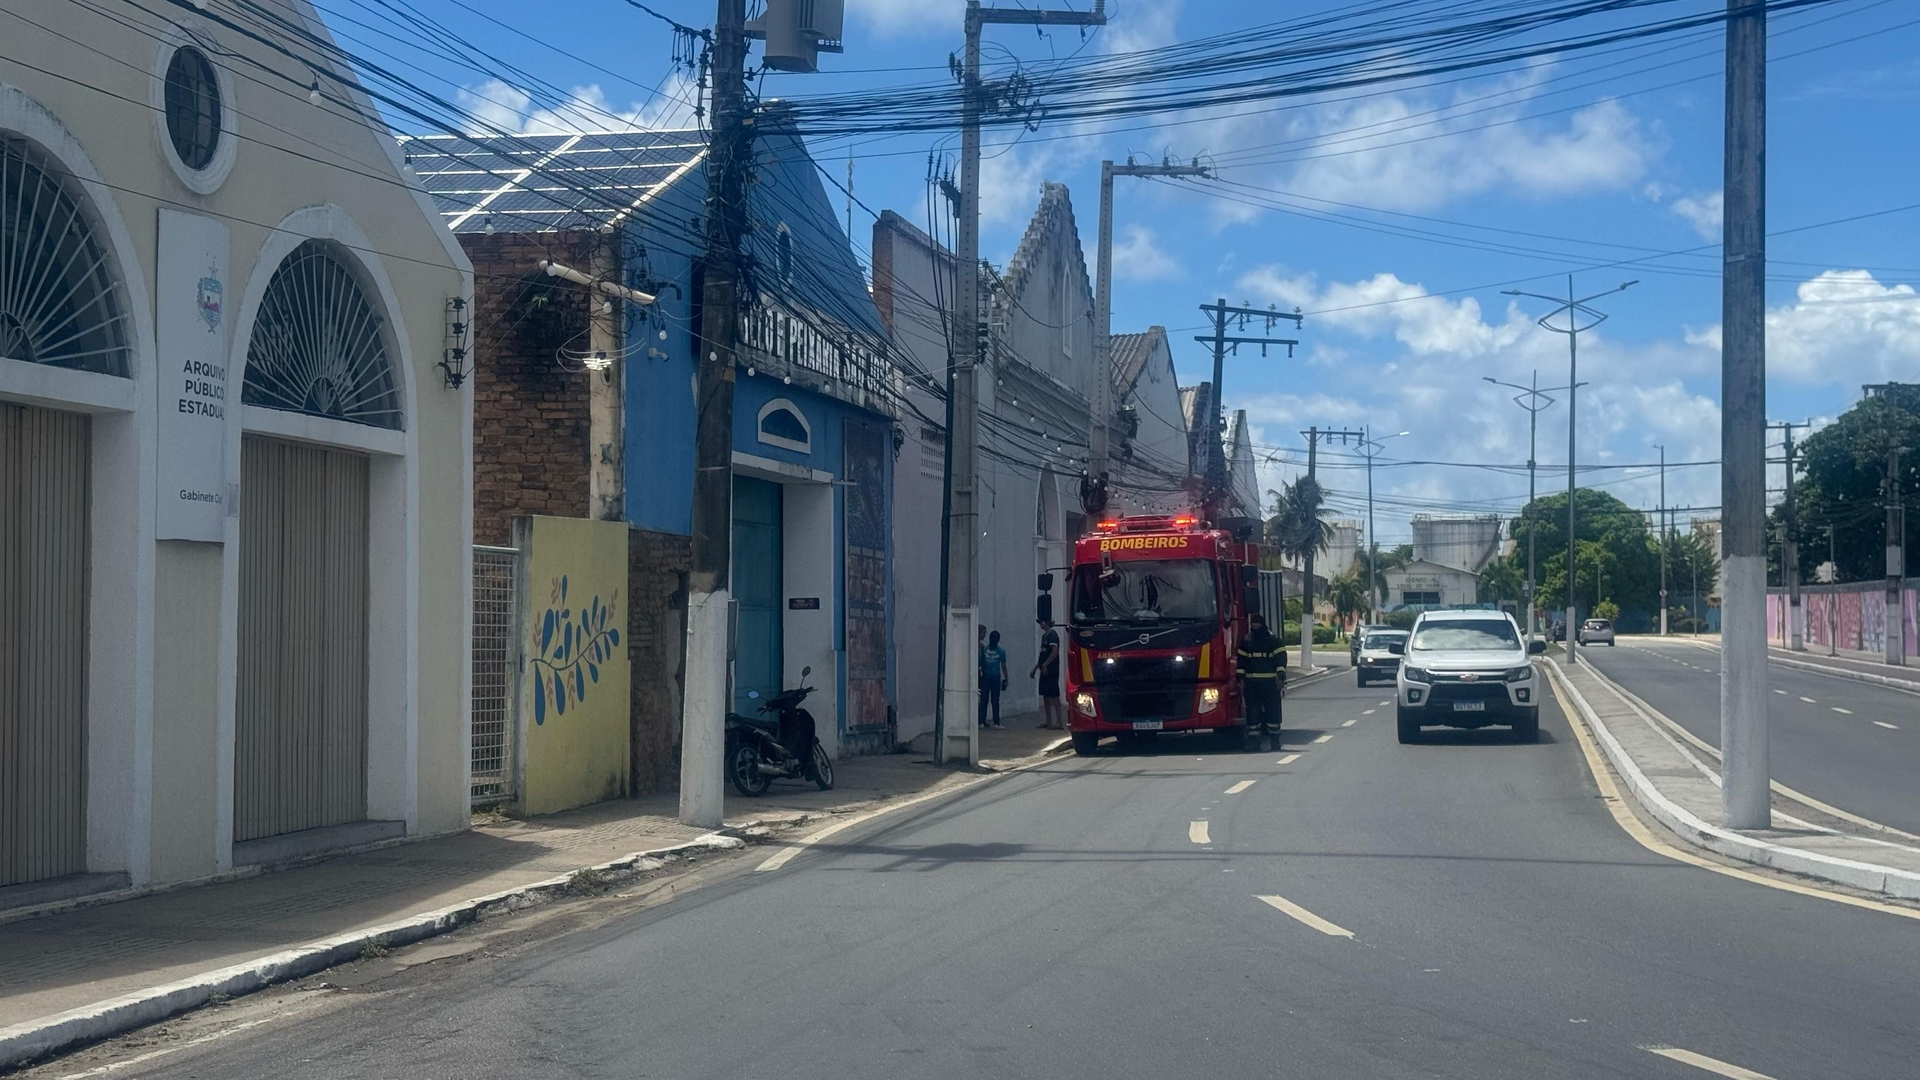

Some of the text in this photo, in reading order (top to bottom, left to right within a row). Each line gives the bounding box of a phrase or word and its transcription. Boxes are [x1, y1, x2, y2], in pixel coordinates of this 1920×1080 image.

[183, 359, 225, 381] ARQUIVO
[185, 378, 224, 400] PÚBLICO
[179, 399, 224, 420] ESTADUAL
[180, 489, 214, 503] Gabinete
[1100, 536, 1188, 551] BOMBEIROS
